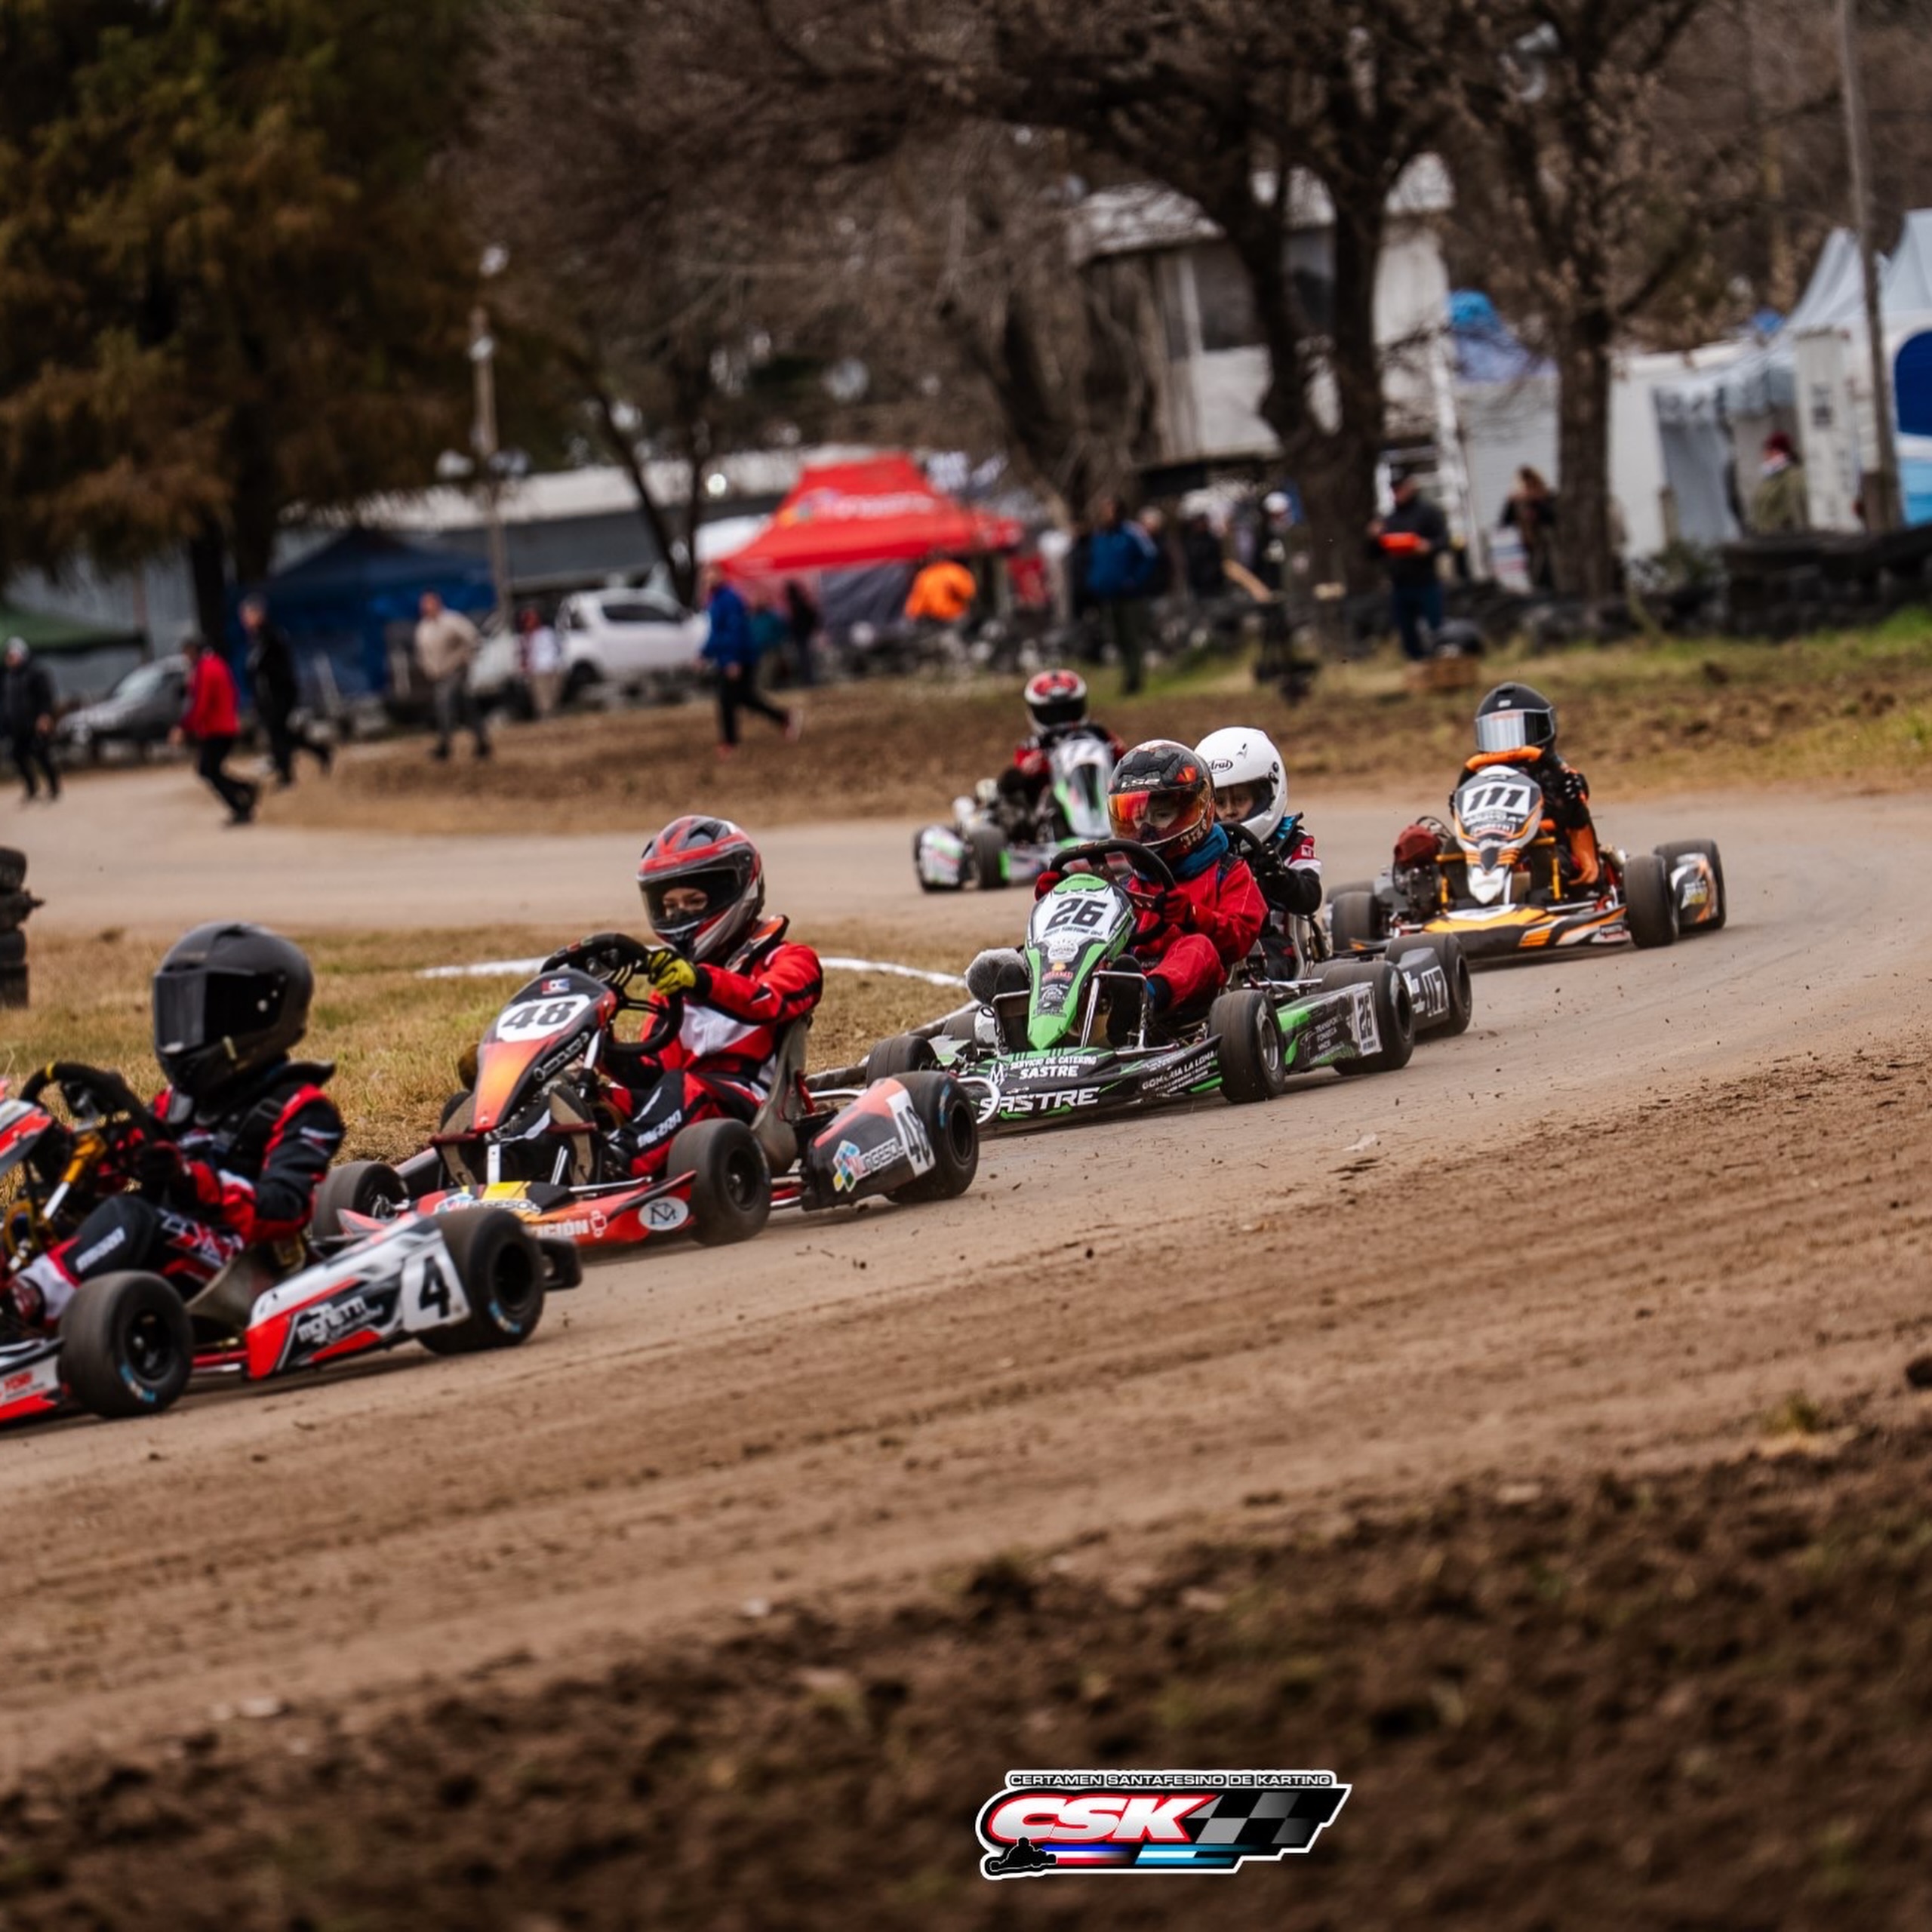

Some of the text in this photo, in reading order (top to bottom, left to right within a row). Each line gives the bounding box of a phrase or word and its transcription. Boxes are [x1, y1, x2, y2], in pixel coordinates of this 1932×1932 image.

[1467, 786, 1525, 813] 111
[1045, 897, 1109, 931] 26
[501, 1000, 579, 1030] 48
[1358, 993, 1374, 1041] 26
[1019, 1065, 1079, 1080] SASTRE
[1058, 1056, 1097, 1066] CATERING
[978, 1087, 1101, 1115] SASTRE
[418, 1256, 451, 1318] 4
